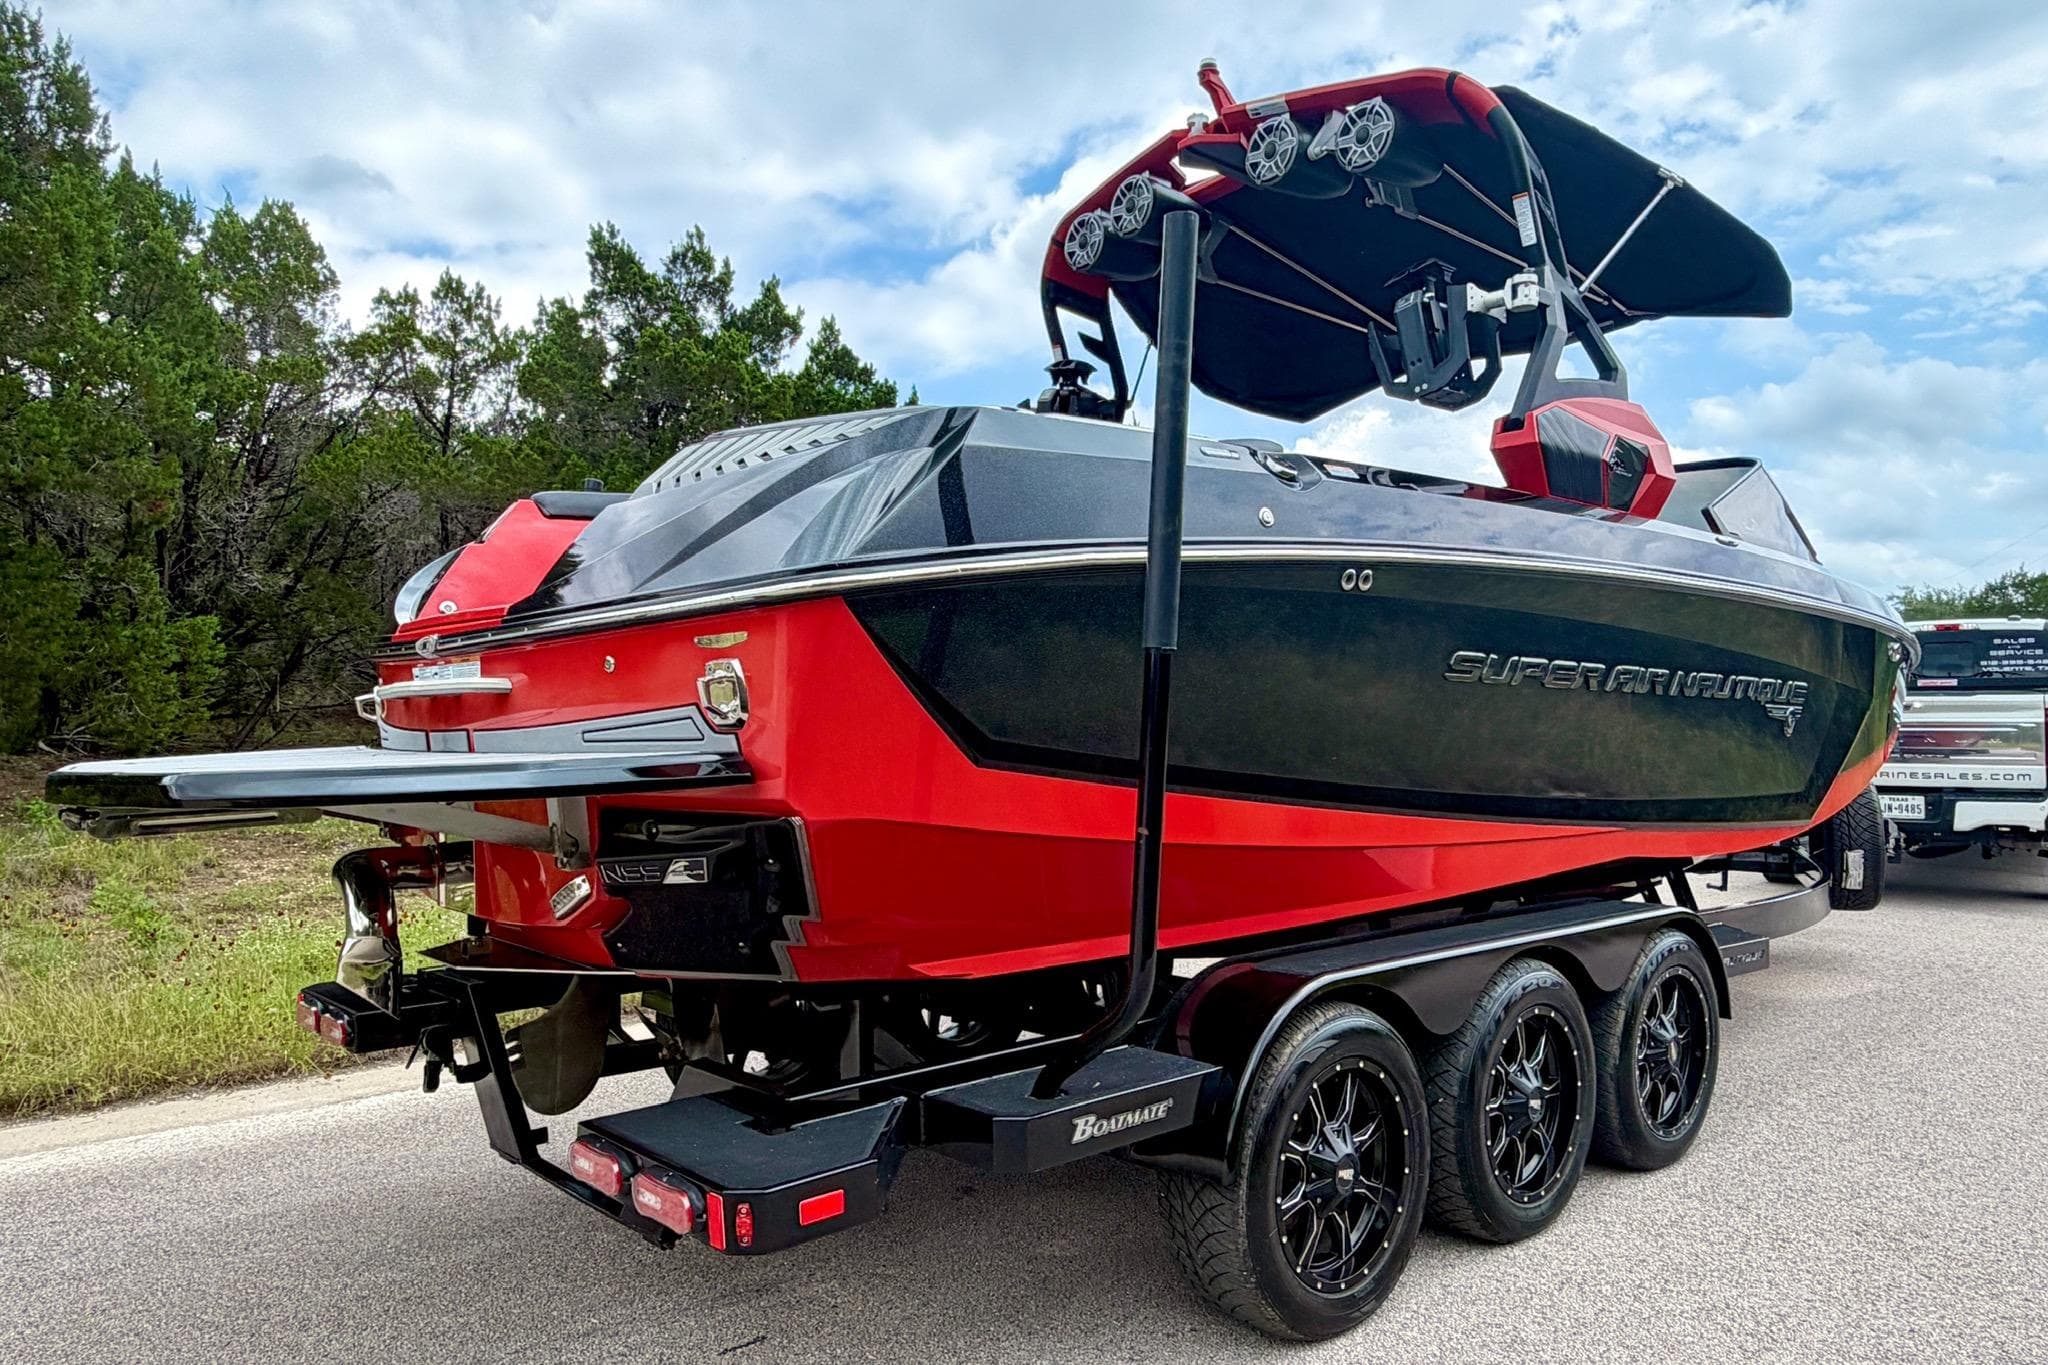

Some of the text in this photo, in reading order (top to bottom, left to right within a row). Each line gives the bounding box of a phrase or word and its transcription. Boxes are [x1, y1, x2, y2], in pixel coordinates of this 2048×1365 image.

[1993, 637, 2036, 645] SALES
[1444, 650, 1808, 705] SUPER AIR NAUTIQUE
